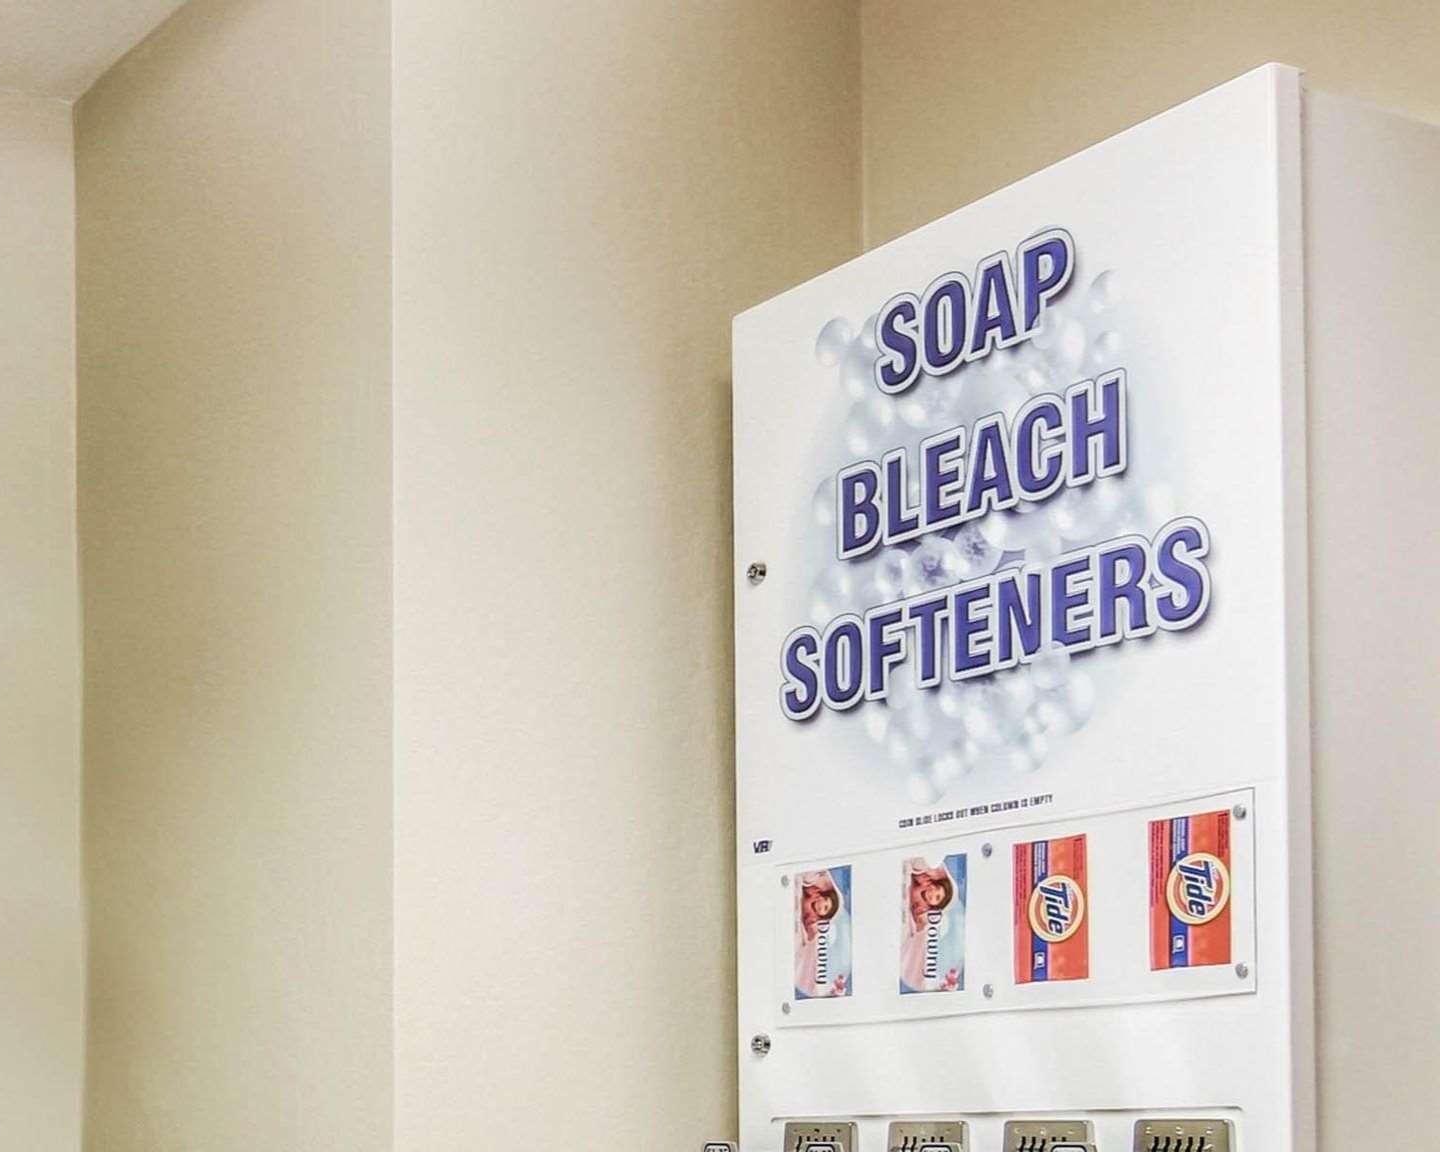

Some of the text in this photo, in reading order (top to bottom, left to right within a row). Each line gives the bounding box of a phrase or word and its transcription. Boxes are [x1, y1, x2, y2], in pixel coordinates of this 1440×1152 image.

[875, 229, 1075, 394] SOAP
[837, 367, 1127, 560] BLEACH
[780, 517, 1210, 720] SOFTENERS
[956, 808, 968, 819] OUT
[970, 805, 989, 816] WHEN
[991, 800, 1019, 813] COLUMN
[1030, 794, 1053, 807] EMPTY
[1039, 881, 1070, 935] Tide
[1179, 859, 1213, 917] Tide
[815, 920, 830, 985] Downy
[923, 911, 942, 979] Downy
